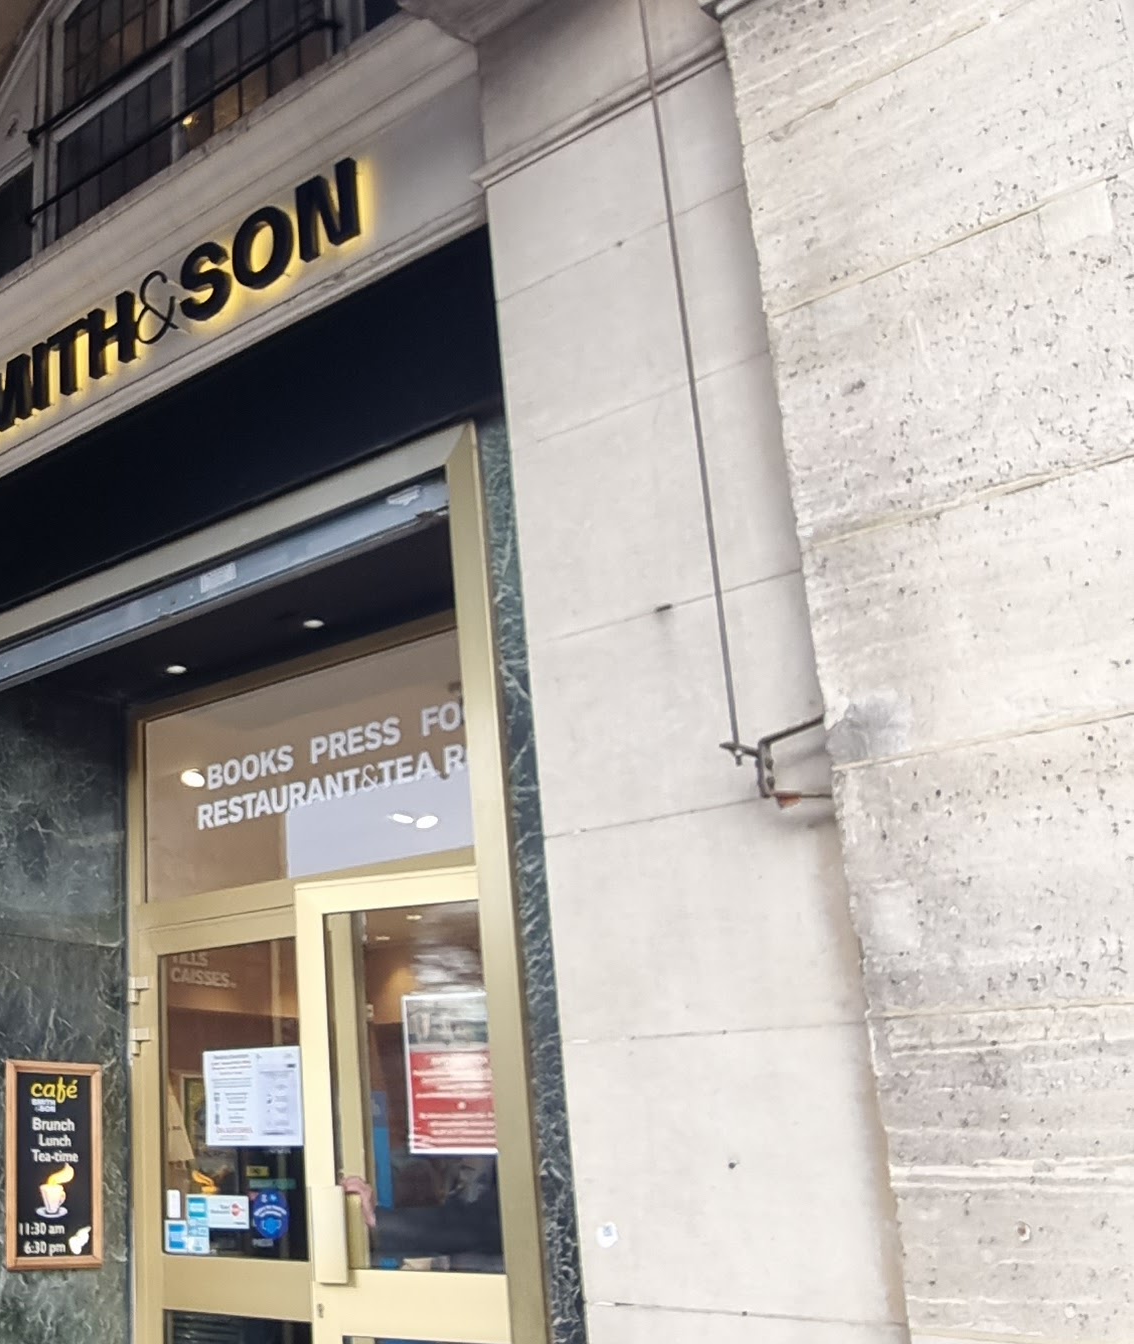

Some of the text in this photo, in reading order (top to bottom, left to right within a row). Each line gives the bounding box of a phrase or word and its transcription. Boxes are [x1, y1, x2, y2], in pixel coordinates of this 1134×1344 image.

[206, 701, 466, 790] BOOKS PRESS FO
[443, 744, 468, 775] R
[30, 1076, 78, 1103] café
[32, 1117, 75, 1131] Brunch
[38, 1134, 72, 1147] Lunch
[30, 1148, 79, 1162] Tea-time
[19, 1222, 65, 1235] 11:30 am
[23, 1241, 66, 1256] 6:30 pm
